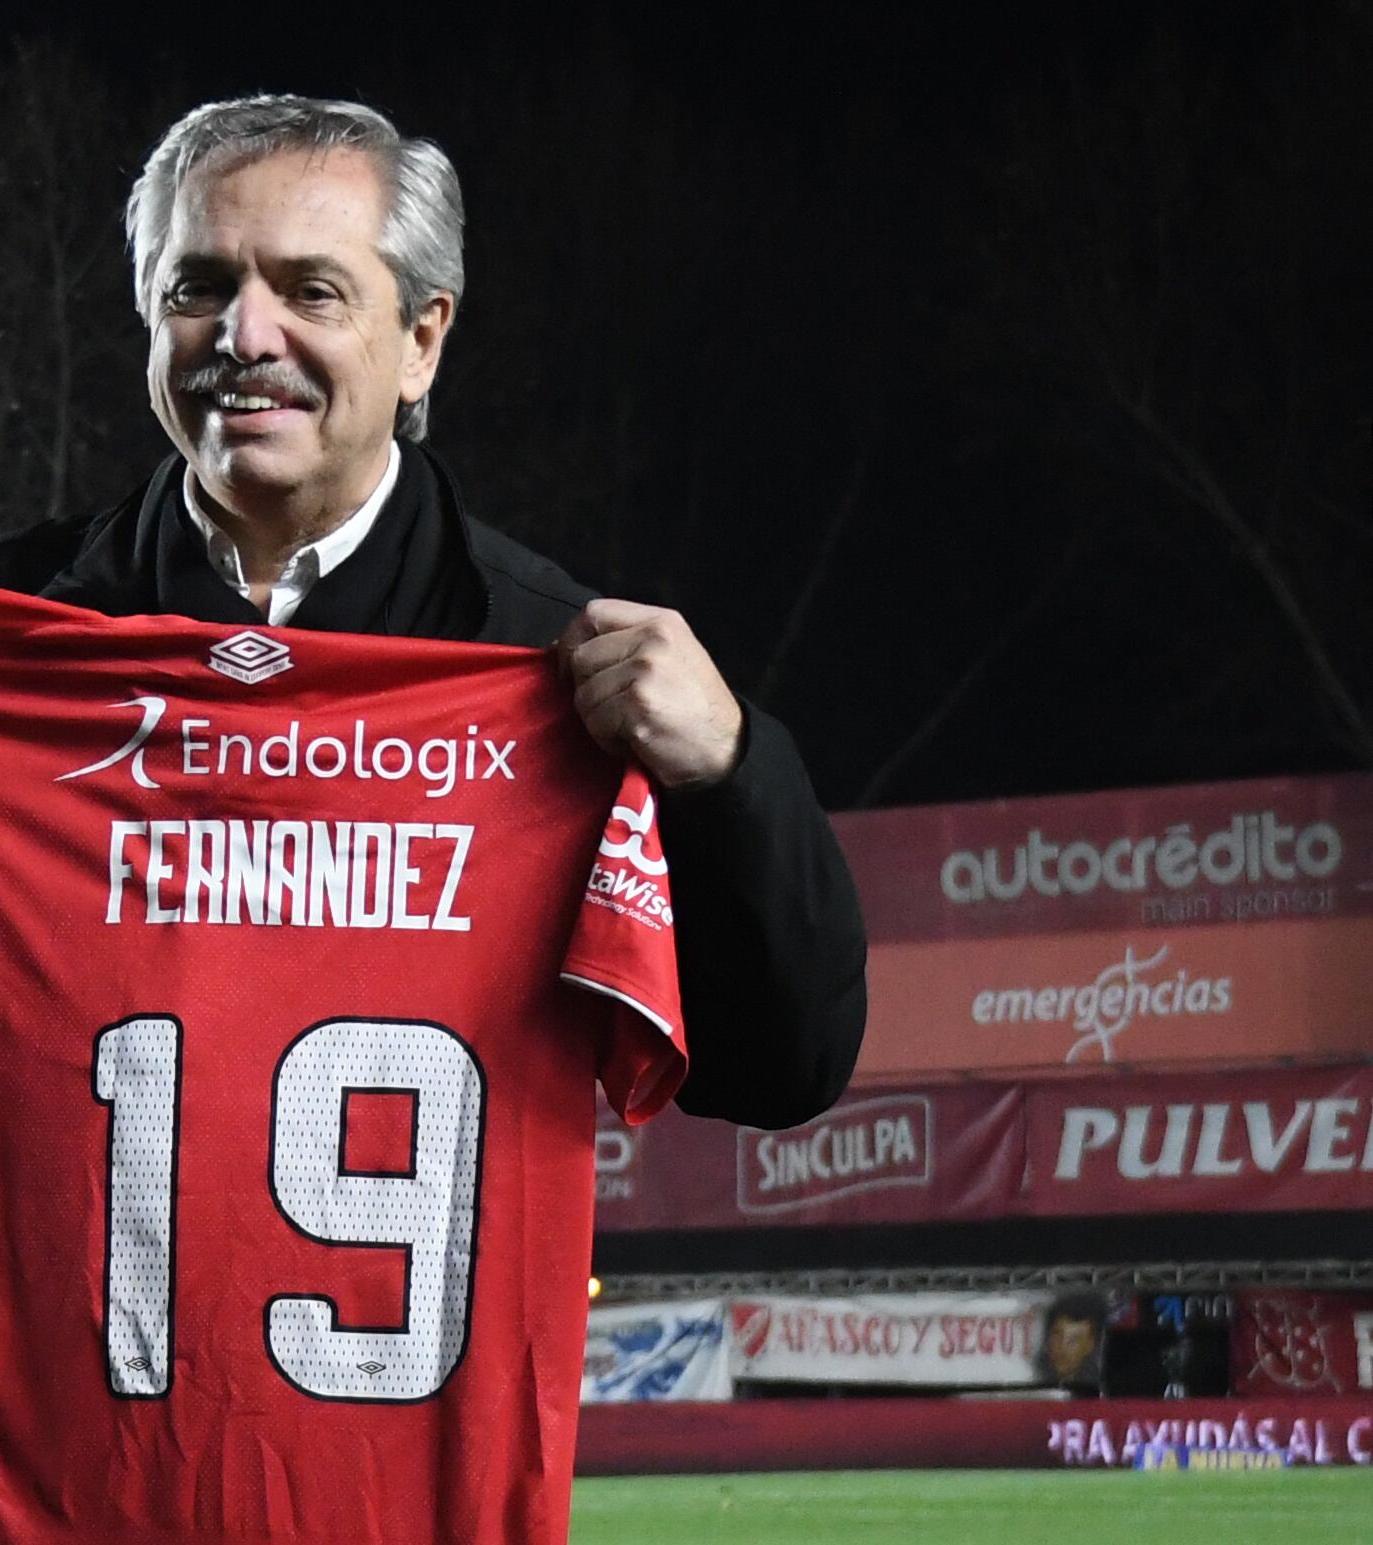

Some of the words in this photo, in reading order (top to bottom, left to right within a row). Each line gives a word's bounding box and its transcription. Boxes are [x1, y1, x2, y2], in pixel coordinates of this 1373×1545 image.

[181, 719, 516, 797] Endologix
[105, 819, 475, 931] FERNANDEZ
[940, 810, 1344, 906] autocrédito
[971, 957, 1233, 1046] emergencias
[1054, 1097, 1373, 1181] PULVE
[92, 1012, 488, 1404] 19
[1289, 1417, 1333, 1465] AL
